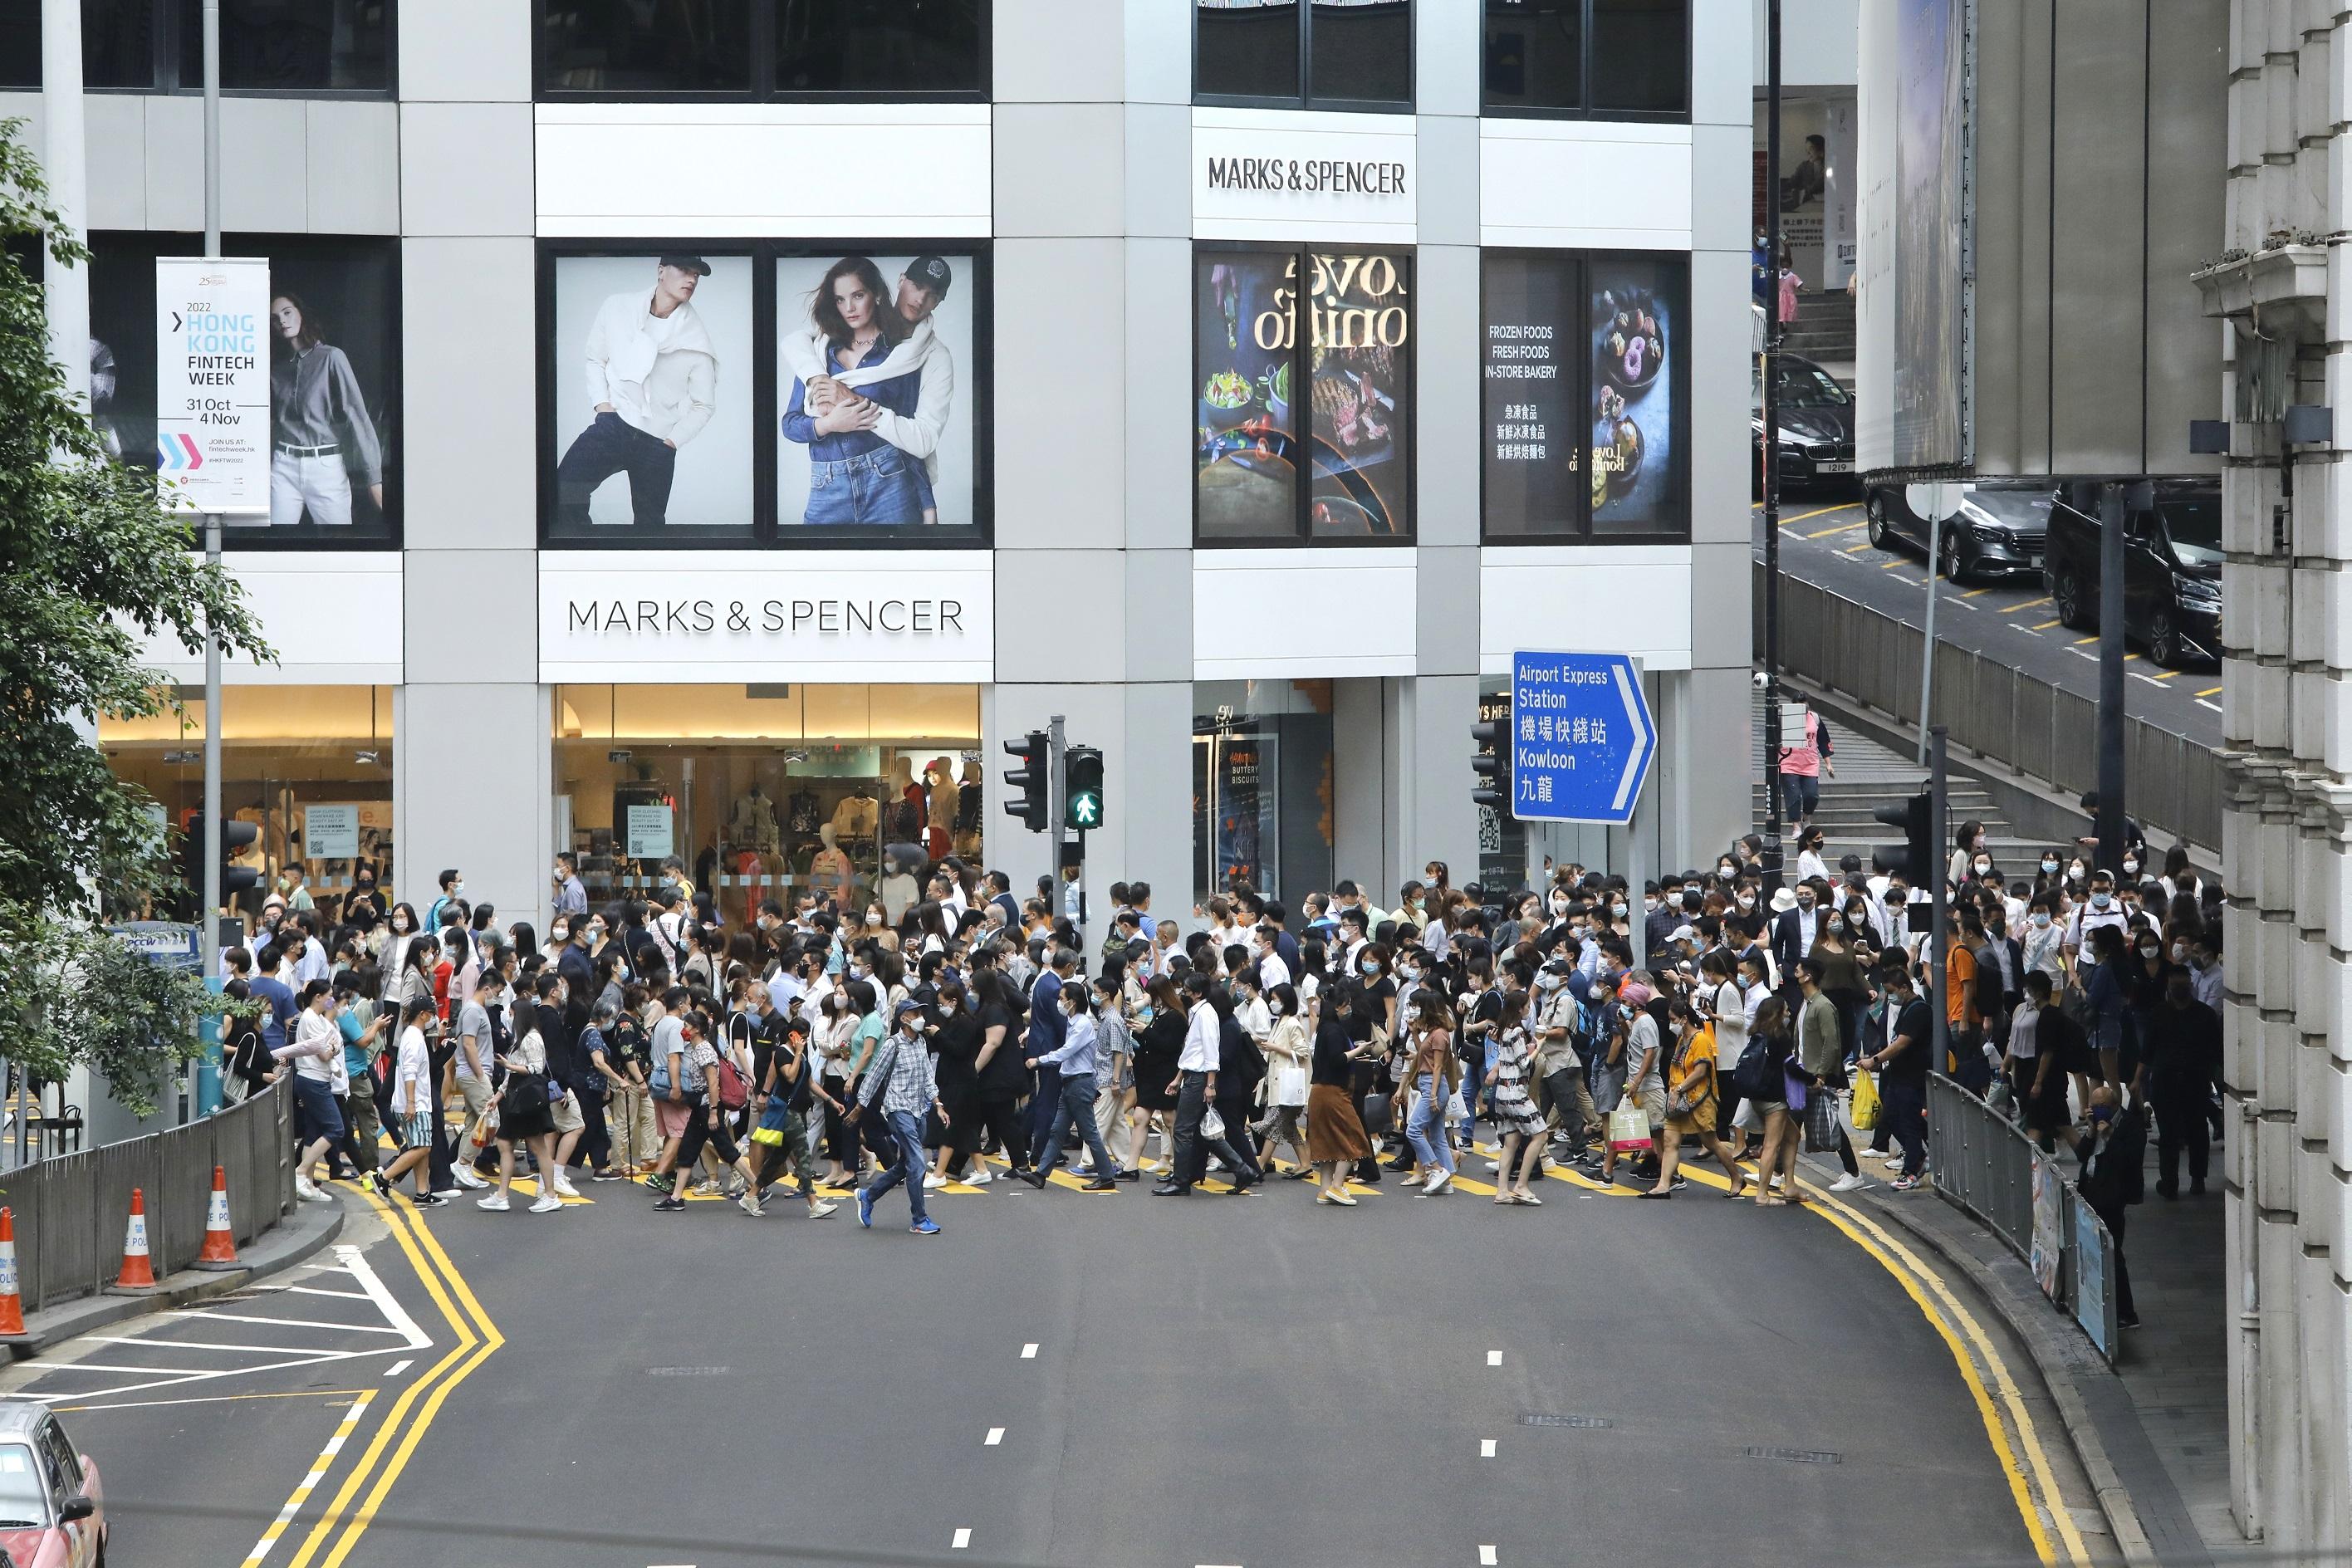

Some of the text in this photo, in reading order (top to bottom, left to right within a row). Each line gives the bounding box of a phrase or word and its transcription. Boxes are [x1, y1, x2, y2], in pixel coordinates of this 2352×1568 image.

[1208, 157, 1405, 194] MARKS & SPENCER
[199, 277, 210, 286] 25
[187, 302, 211, 312] 2022
[187, 314, 254, 332] HONG
[1490, 326, 1553, 340] FROZEN FOODS
[188, 335, 255, 353] KONG
[1492, 345, 1550, 359] FRESH FOODS
[189, 356, 254, 369] FINTECH
[189, 373, 235, 385] WEEK
[1485, 365, 1557, 379] IN-STORE BAKERY
[187, 399, 231, 410] 31 Oct
[1505, 404, 1537, 420] 急凍食品
[200, 413, 240, 425] 4 Nov
[1497, 424, 1546, 440] 新鮮冰凍食品
[1497, 443, 1546, 460] 新鮮烘焙麵包
[1828, 463, 1847, 472] 1219
[568, 600, 964, 632] MARKS & SPENCER
[1519, 665, 1608, 687] Airport Express
[1519, 688, 1566, 708] Station
[1521, 715, 1607, 745] 機場快綫站
[1519, 748, 1575, 770] Kowloon
[1232, 766, 1259, 774] BUTTERY
[1232, 776, 1260, 784] BISCUITS
[1521, 774, 1553, 802] 九龍
